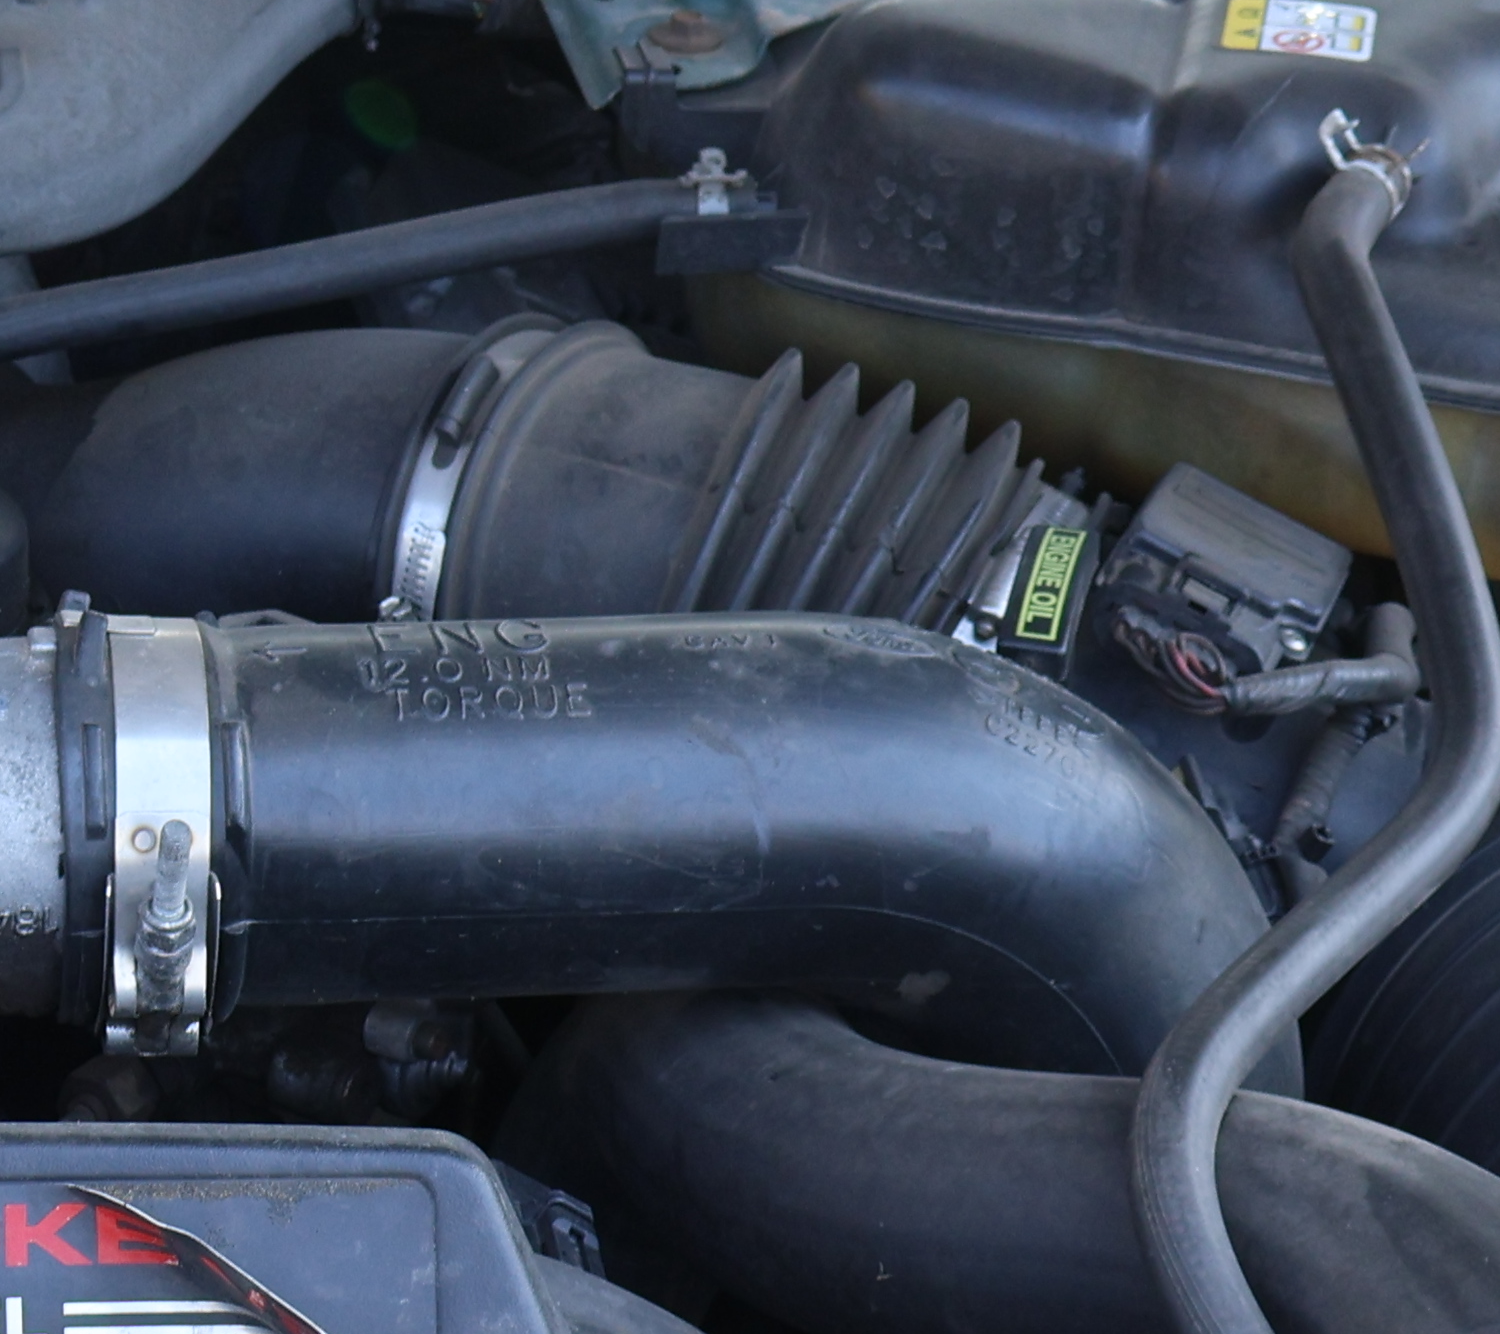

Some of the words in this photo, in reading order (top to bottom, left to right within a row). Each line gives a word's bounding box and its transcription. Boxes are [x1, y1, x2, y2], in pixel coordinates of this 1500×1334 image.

[1036, 535, 1077, 588] ENGINE
[1027, 591, 1057, 623] OIL
[365, 618, 550, 655] ENG
[483, 655, 551, 682] NM
[386, 683, 593, 720] TORQUE
